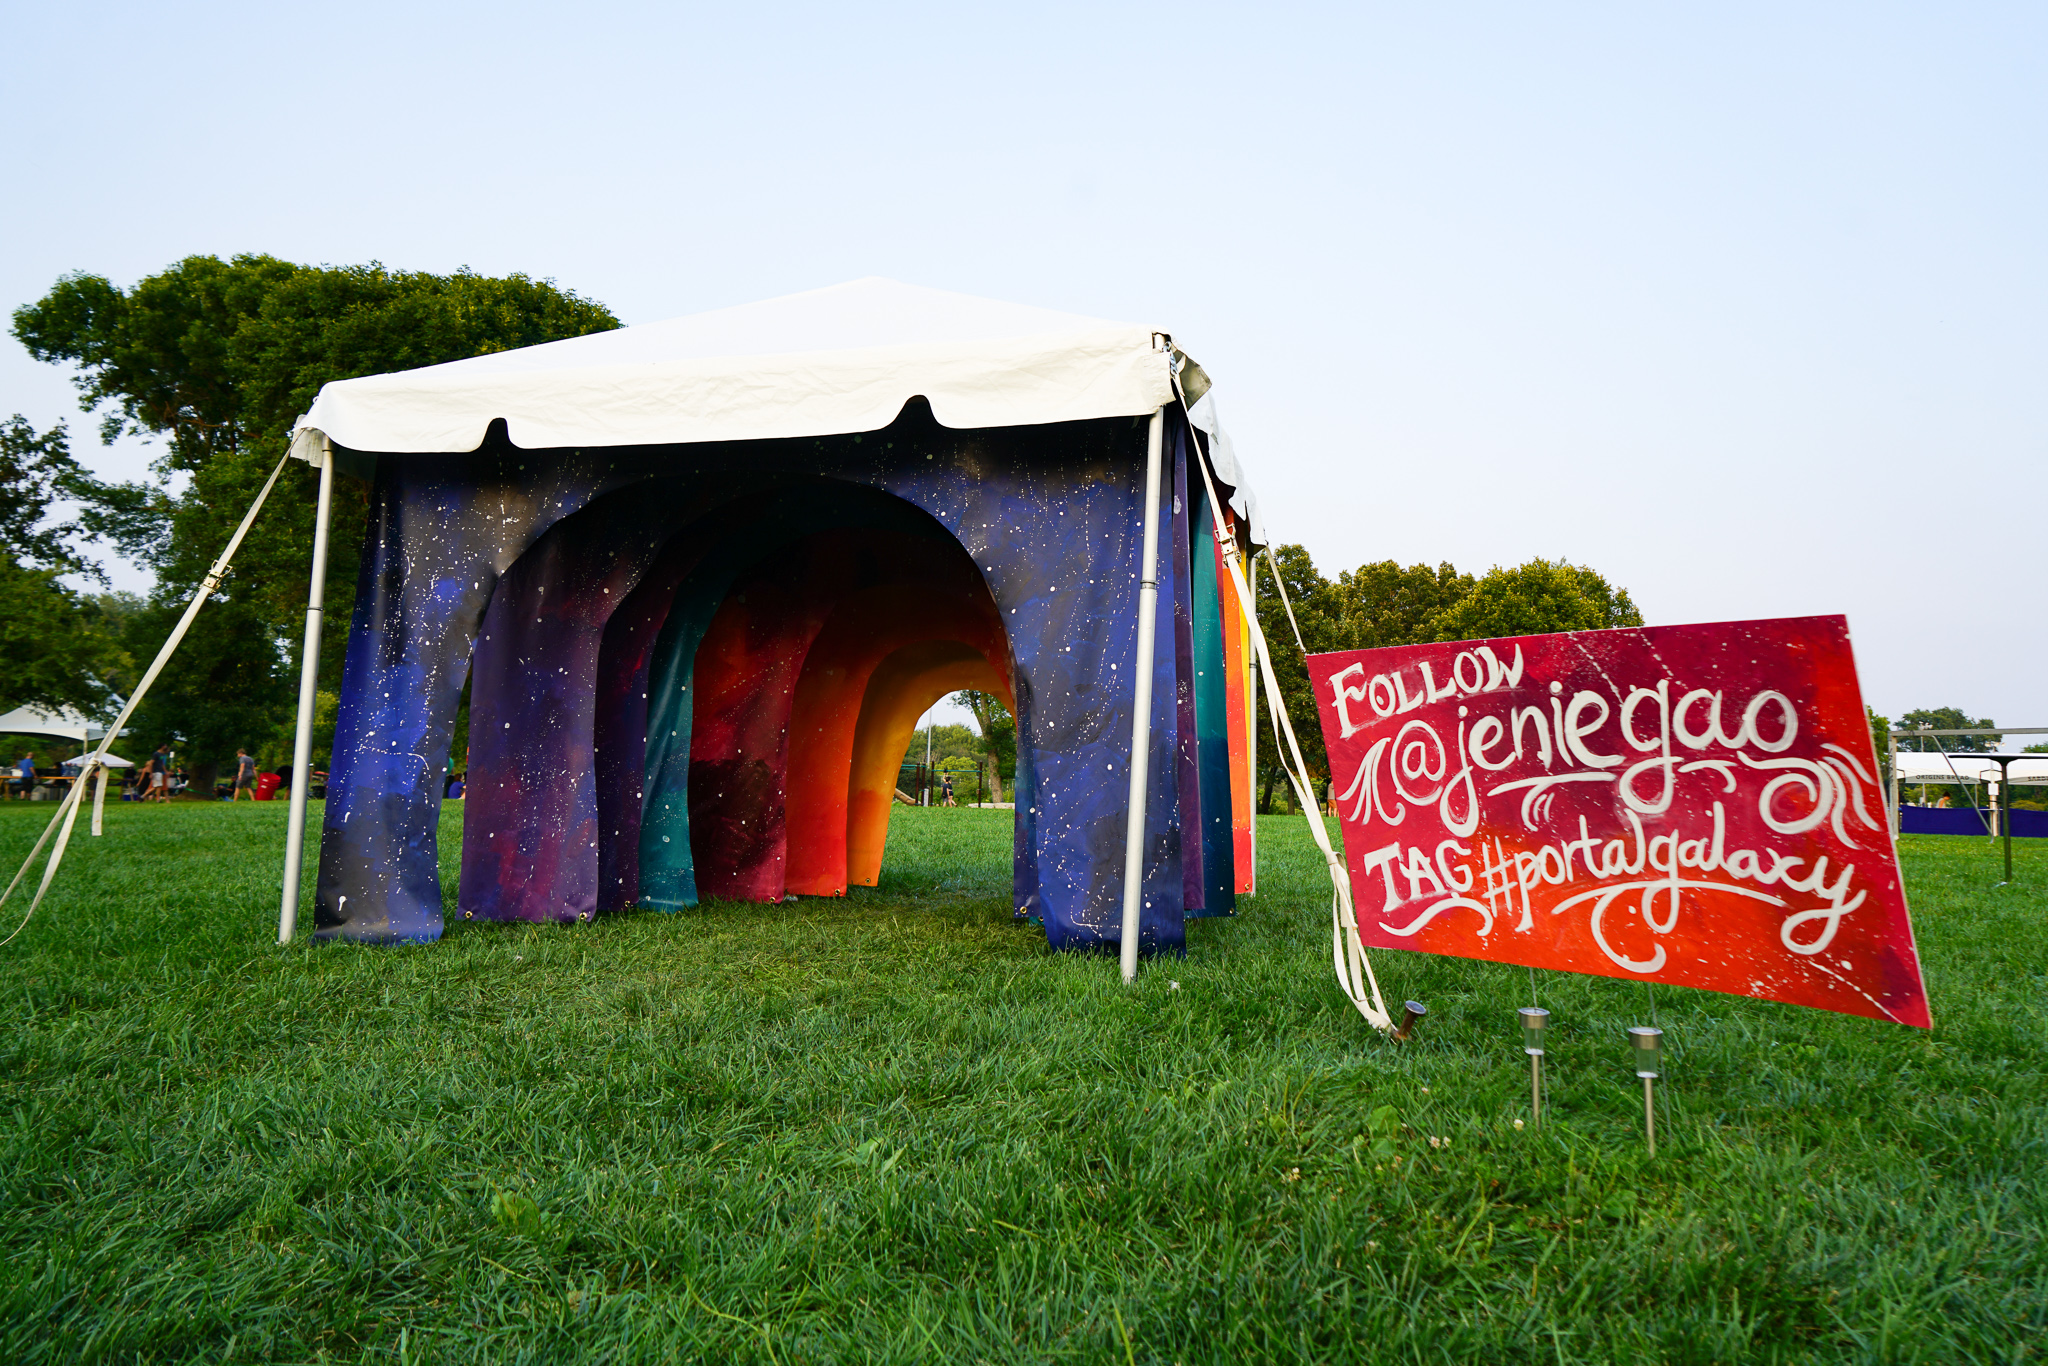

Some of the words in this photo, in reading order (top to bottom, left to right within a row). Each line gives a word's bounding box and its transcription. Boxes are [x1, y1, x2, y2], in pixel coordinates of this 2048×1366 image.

[1329, 643, 1524, 739] FOLLOW
[1389, 678, 1799, 838] @jeniegao
[1363, 839, 1474, 912] TAG
[1479, 801, 1867, 955] #portalgalaxy
